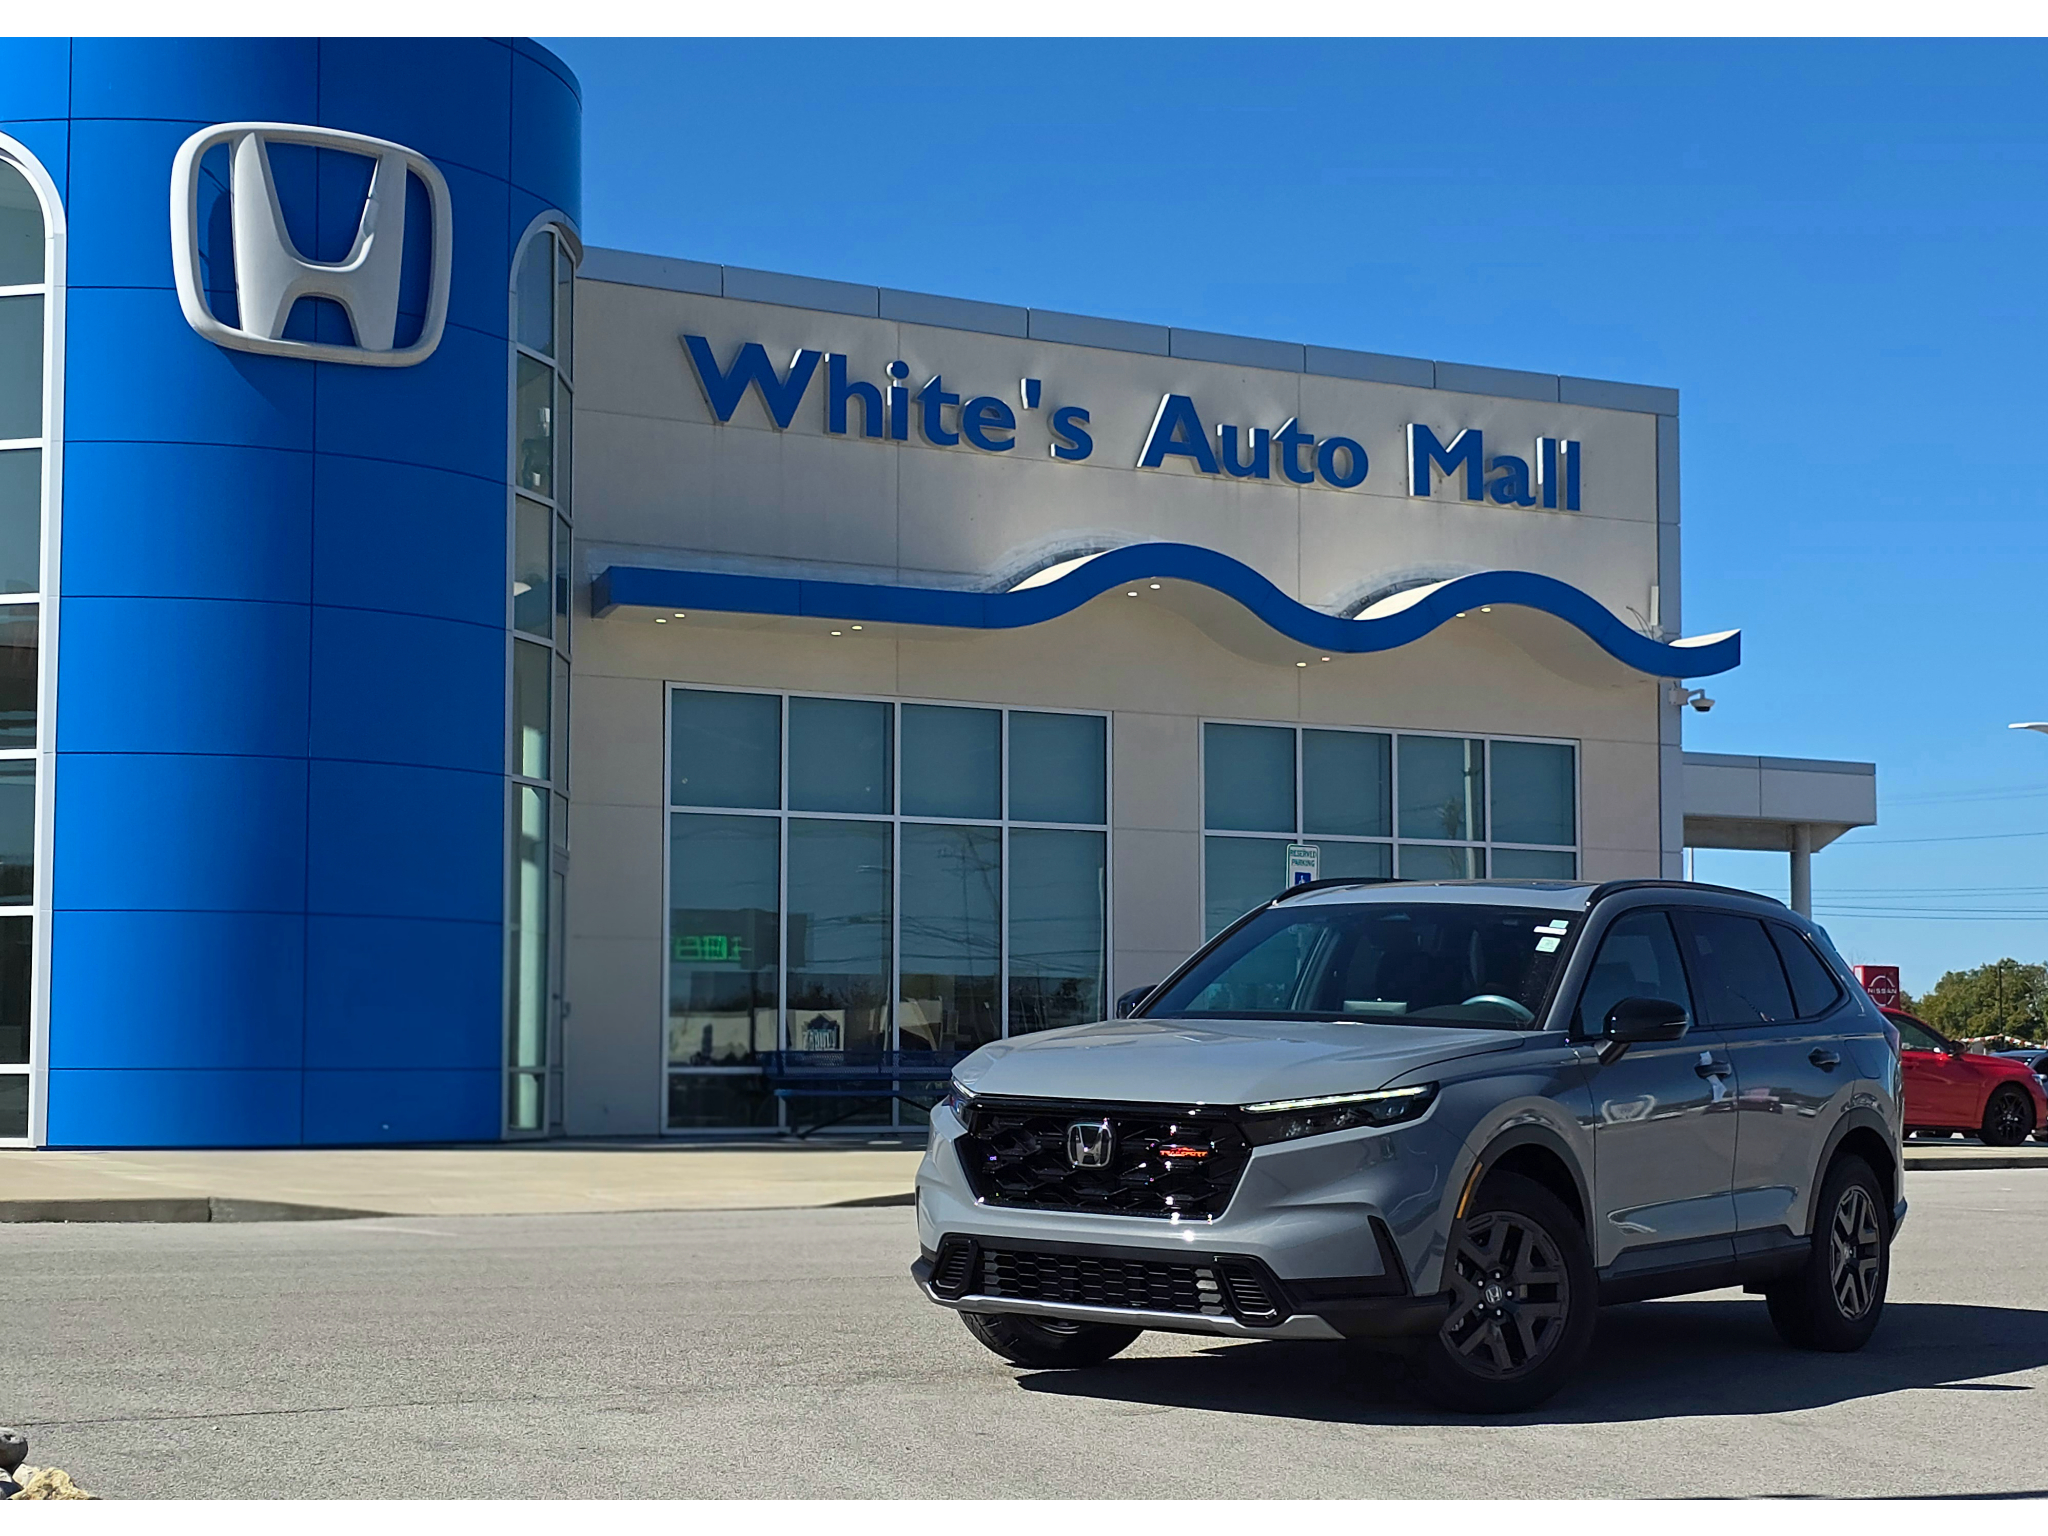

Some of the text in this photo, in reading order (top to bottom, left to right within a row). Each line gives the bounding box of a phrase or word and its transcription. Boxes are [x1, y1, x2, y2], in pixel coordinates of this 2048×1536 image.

[680, 334, 1581, 511] White's Auto Mall
[1290, 849, 1316, 858] RESERVED
[1291, 859, 1315, 867] PARKING
